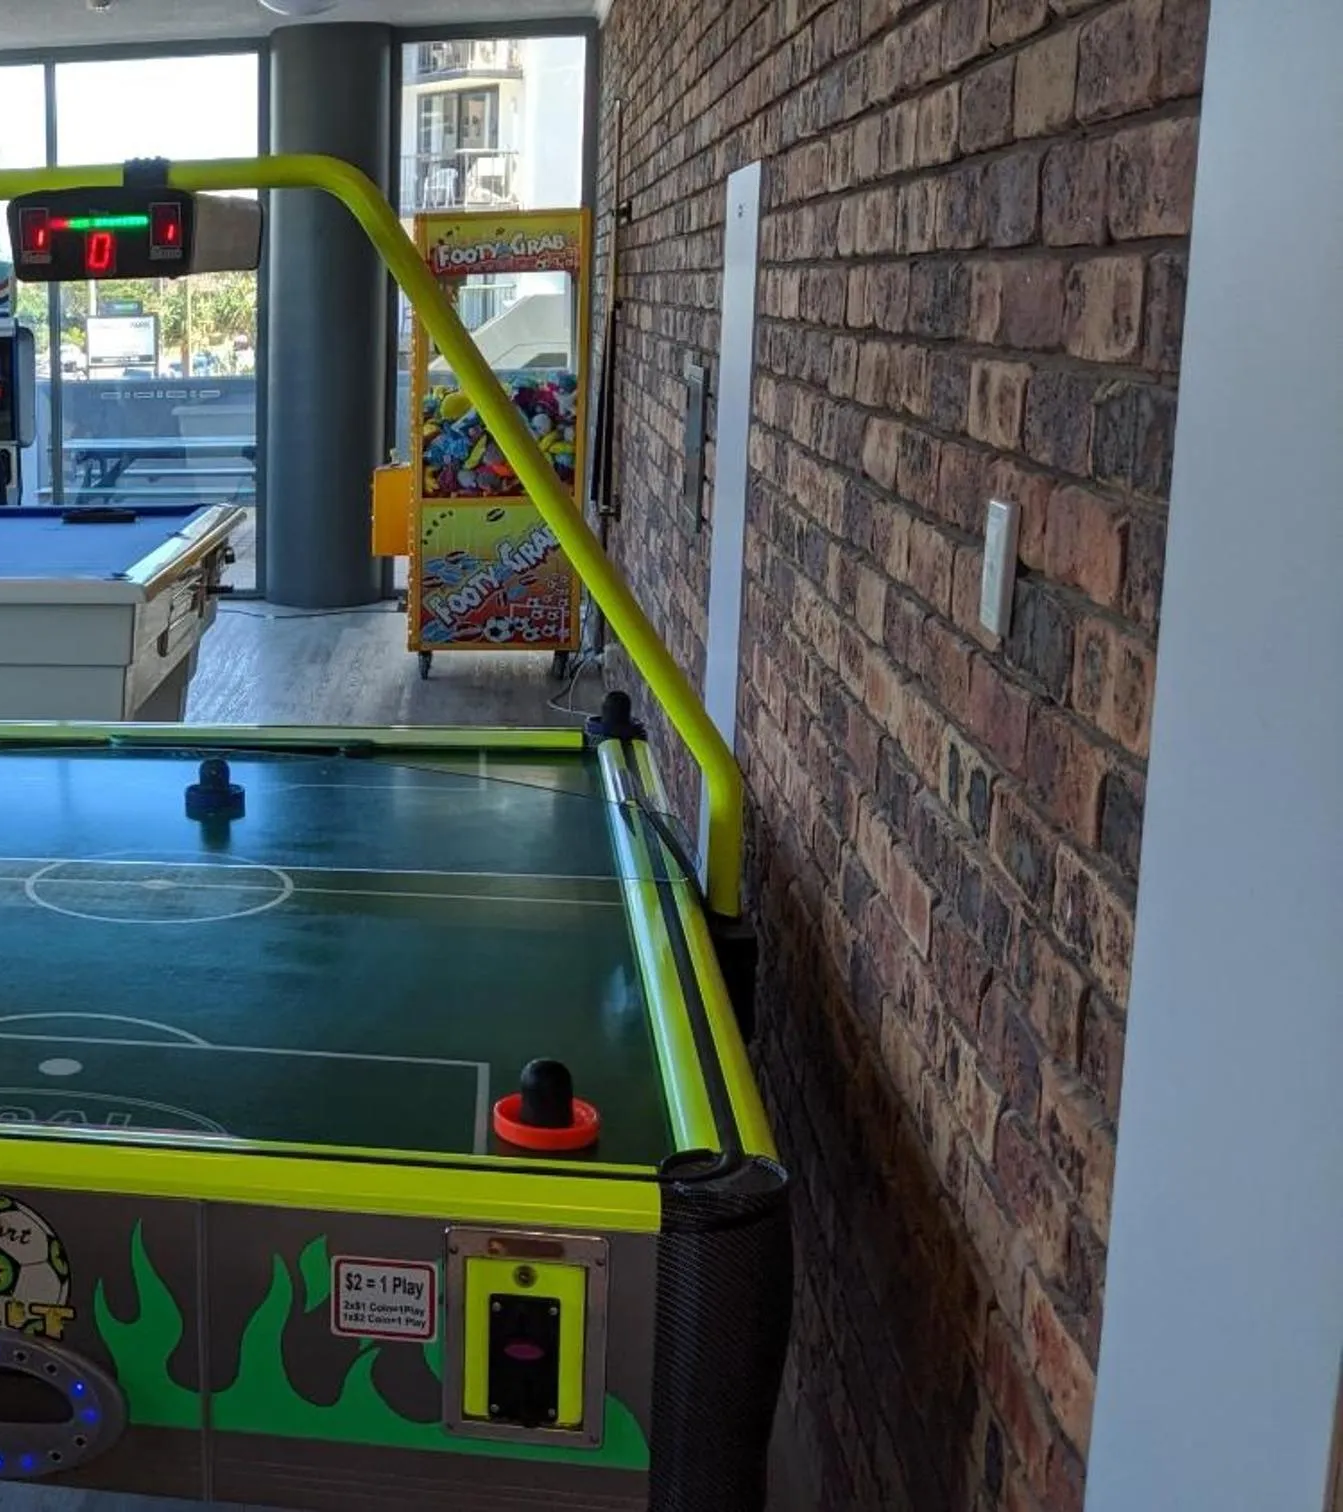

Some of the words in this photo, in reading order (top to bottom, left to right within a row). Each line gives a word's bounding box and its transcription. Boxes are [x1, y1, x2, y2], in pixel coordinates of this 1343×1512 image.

[510, 232, 565, 256] GRAB
[496, 526, 559, 573] GRA
[345, 1272, 363, 1292] $2
[380, 1275, 387, 1293] 1
[392, 1276, 424, 1300] Play
